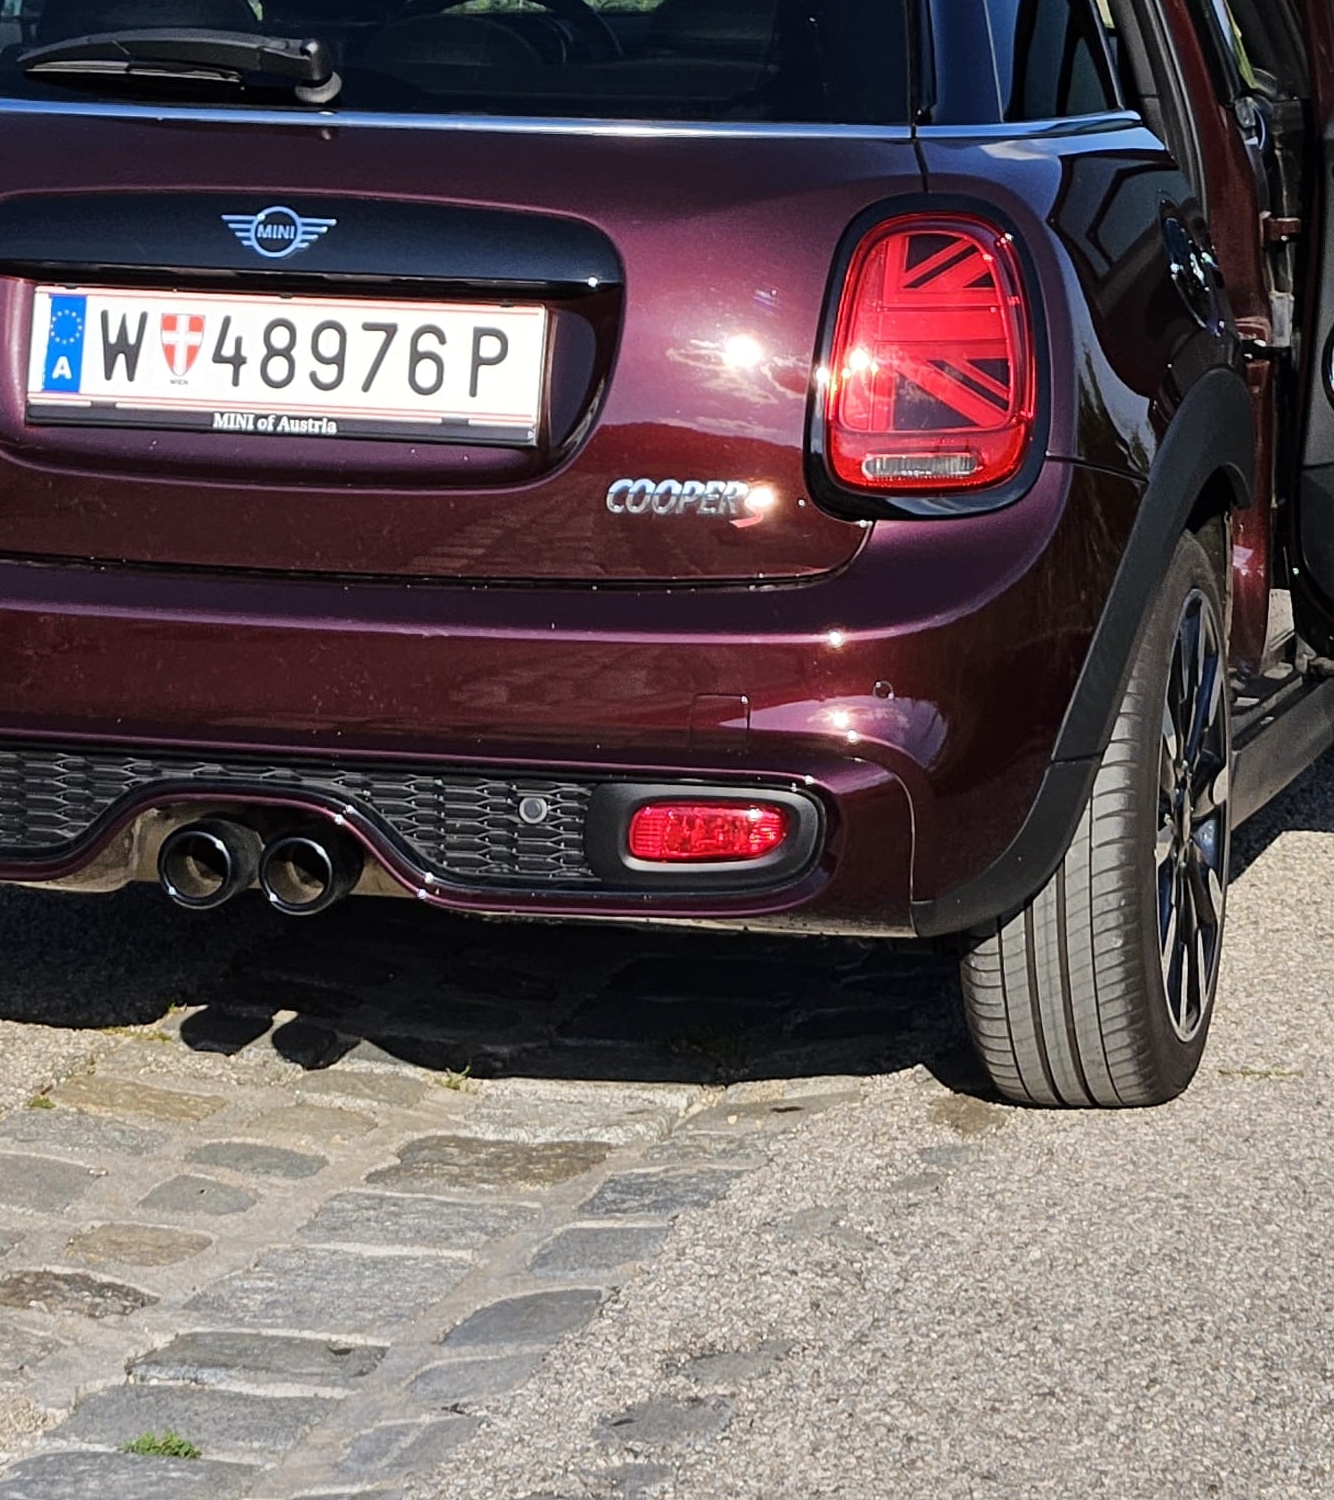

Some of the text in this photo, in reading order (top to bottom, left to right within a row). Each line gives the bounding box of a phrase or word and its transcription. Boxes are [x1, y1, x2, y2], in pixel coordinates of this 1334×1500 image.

[257, 224, 295, 239] MINI
[100, 309, 148, 382] W
[52, 356, 72, 380] A
[213, 412, 337, 435] MINI of Austria
[606, 478, 749, 514] COOPER
